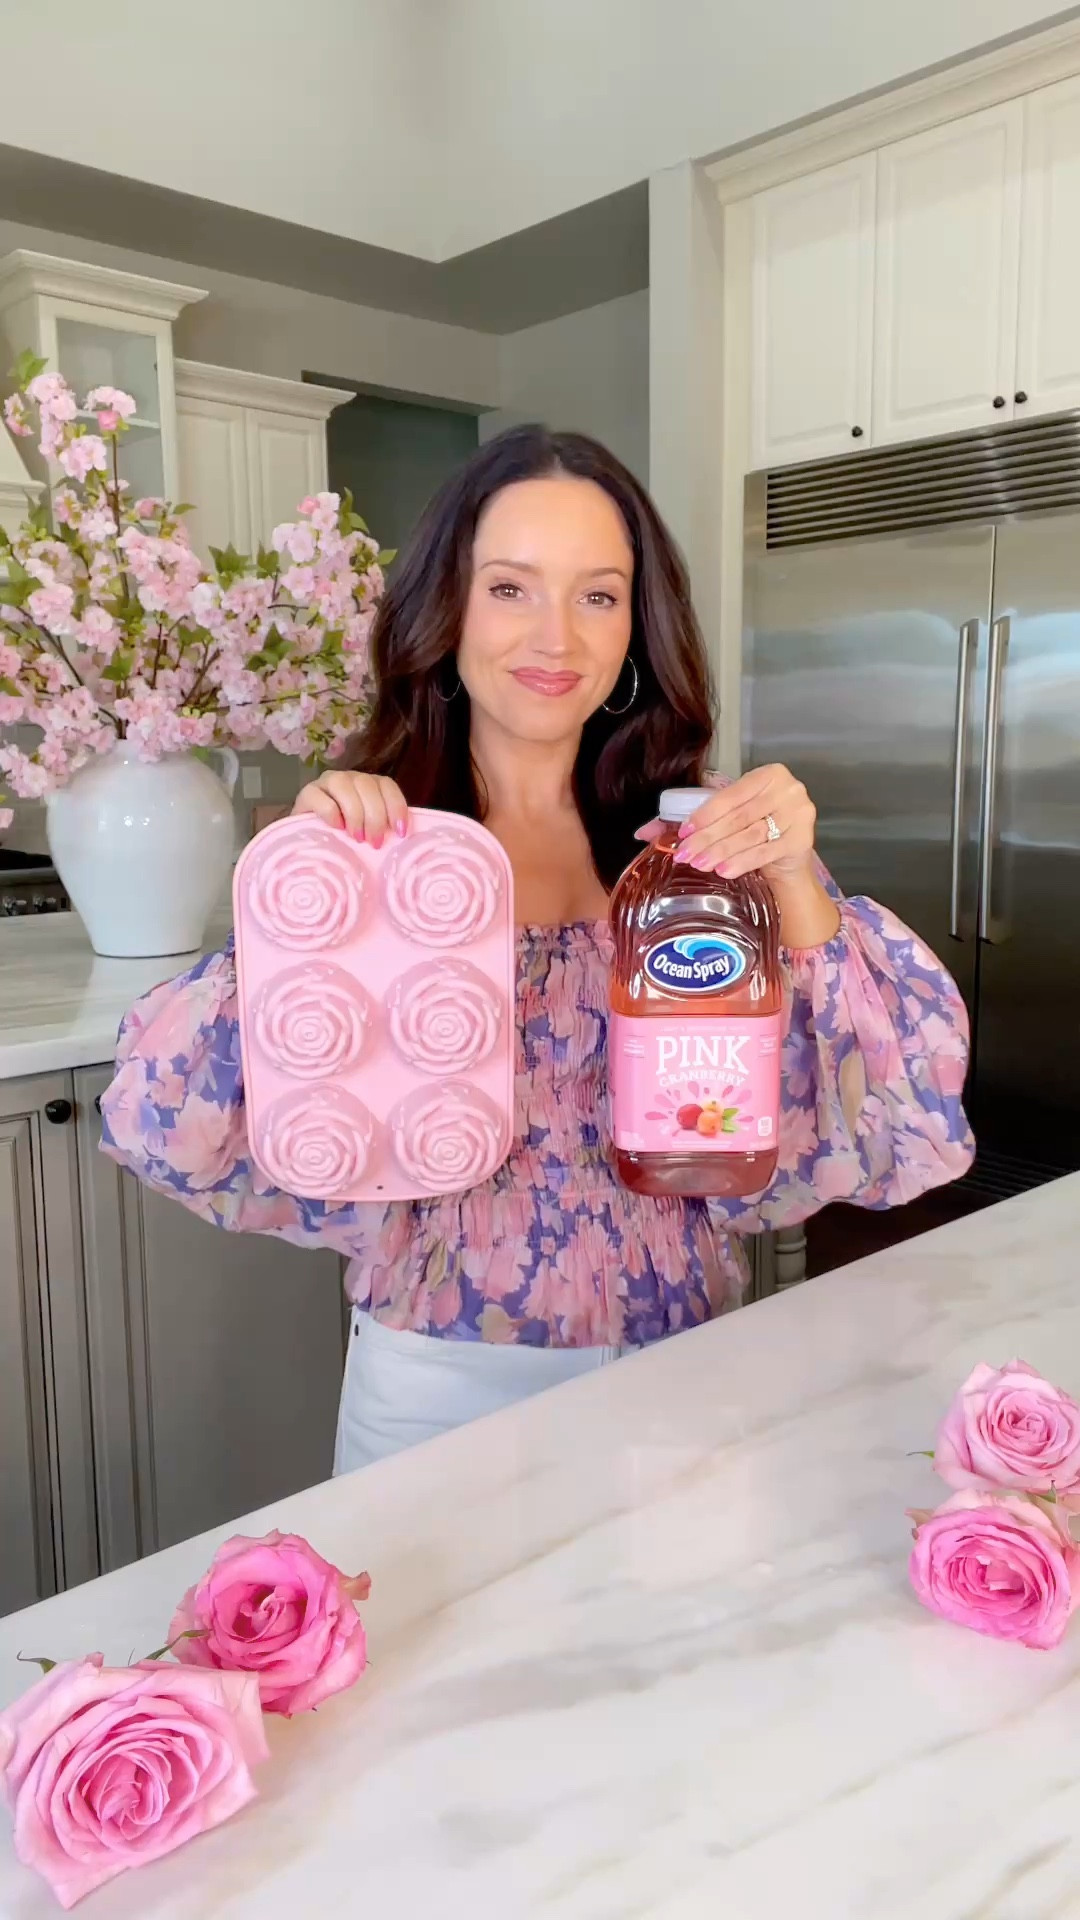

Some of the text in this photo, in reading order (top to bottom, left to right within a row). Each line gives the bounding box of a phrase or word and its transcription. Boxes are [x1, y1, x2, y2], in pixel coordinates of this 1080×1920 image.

[653, 954, 730, 982] Ocean Spray
[655, 1035, 750, 1075] PINK
[659, 1069, 746, 1087] CRANBERRY
